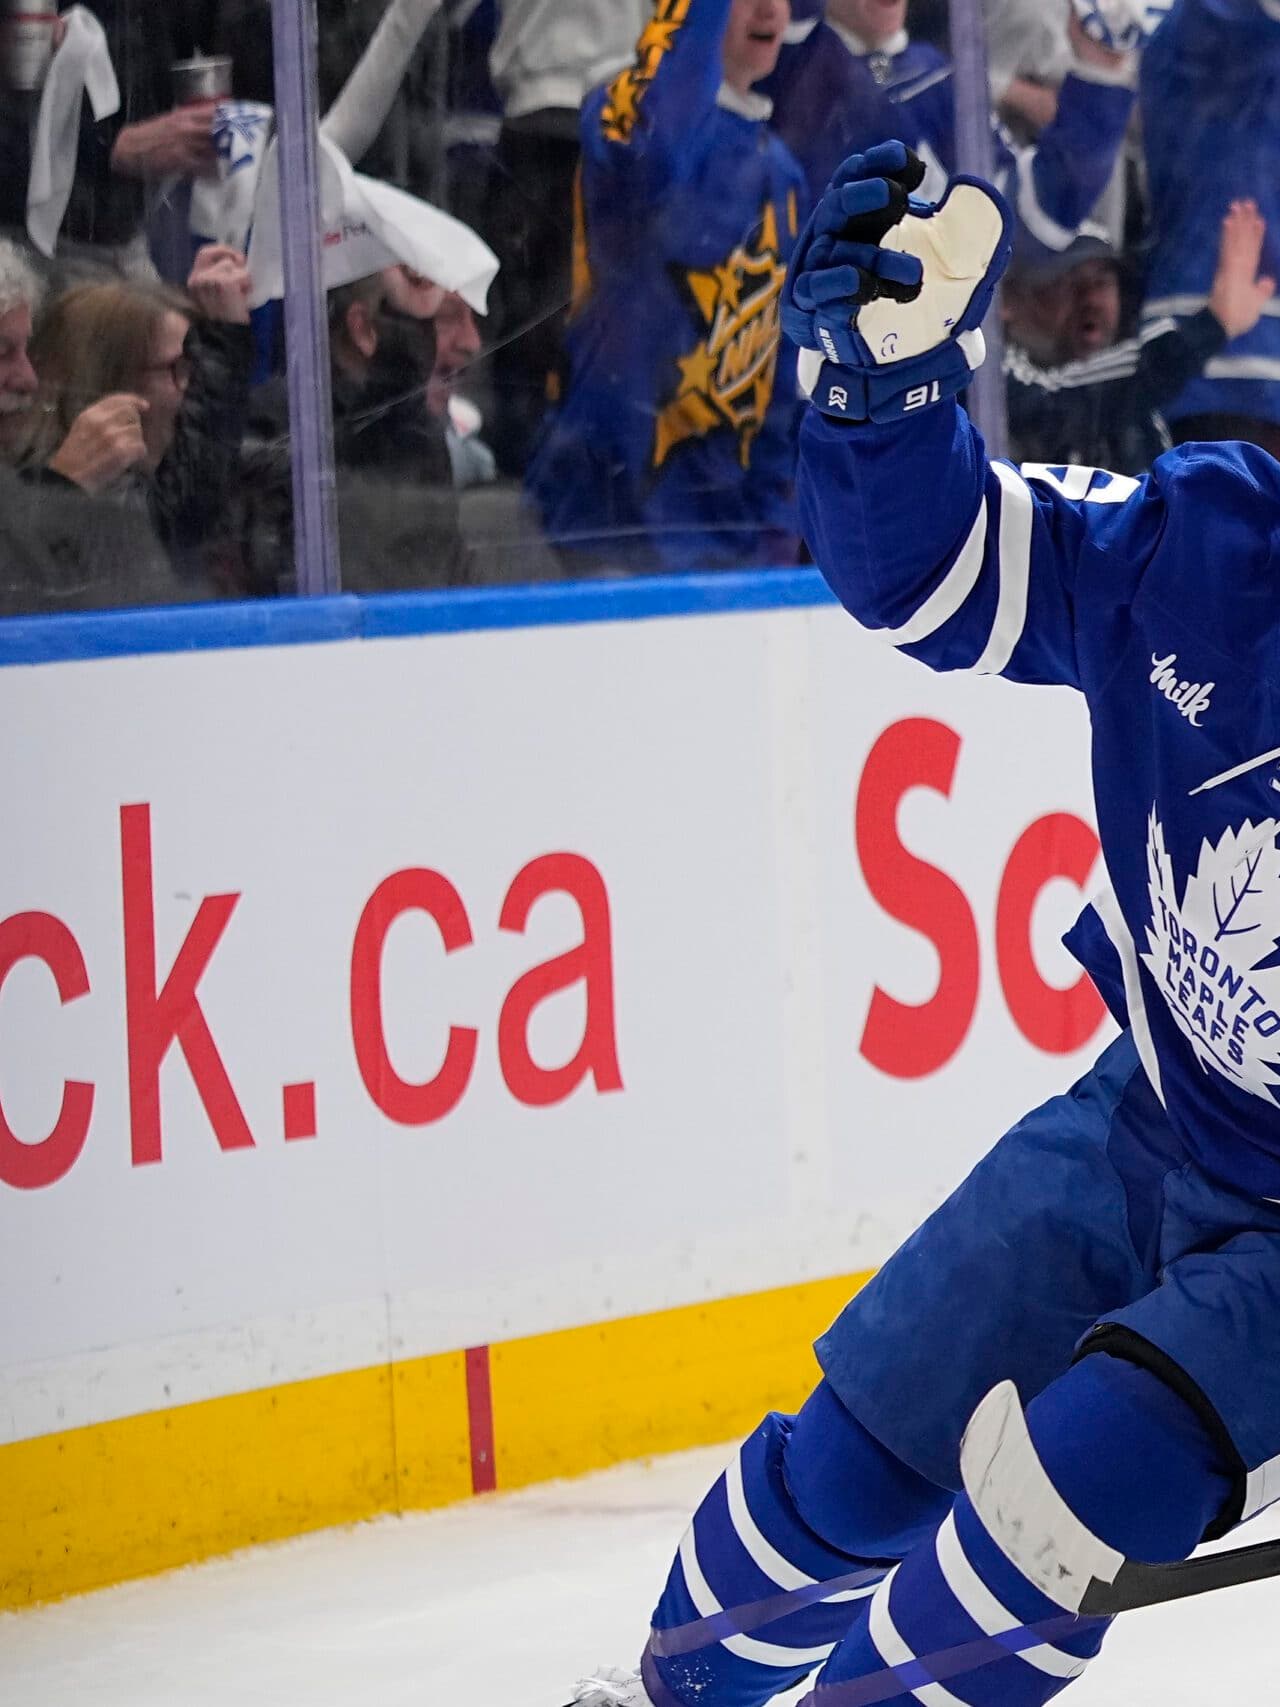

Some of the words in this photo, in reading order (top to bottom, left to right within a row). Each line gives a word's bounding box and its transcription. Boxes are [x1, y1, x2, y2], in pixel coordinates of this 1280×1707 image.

[903, 380, 942, 411] 16
[1149, 651, 1216, 727] Milk
[0, 802, 625, 1191] ck.ca
[1166, 962, 1244, 1066] LEAFS
[1168, 939, 1250, 1044] MAPLE
